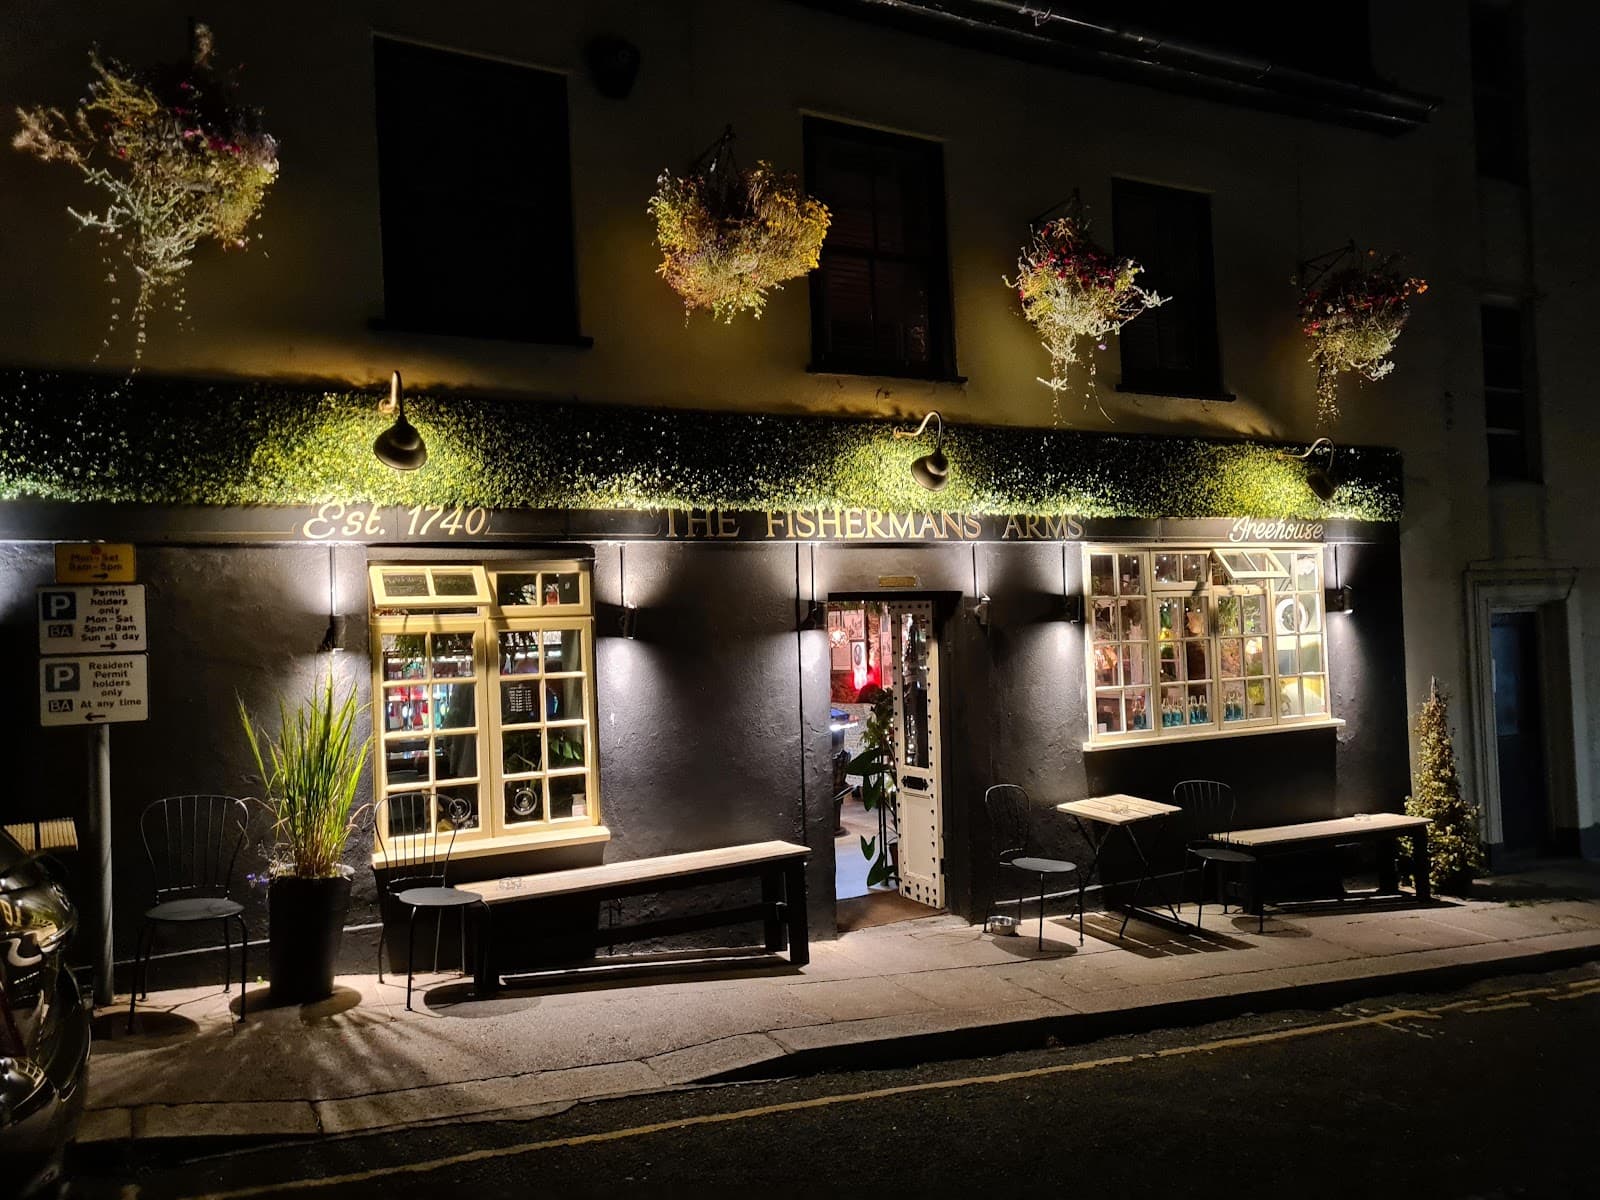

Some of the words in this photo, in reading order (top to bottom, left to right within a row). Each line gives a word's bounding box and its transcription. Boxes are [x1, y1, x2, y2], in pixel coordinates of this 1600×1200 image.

[302, 501, 386, 539] Est.
[407, 503, 486, 536] 1740
[666, 506, 741, 539] THE
[766, 506, 982, 540] FISHERMANS
[1002, 511, 1084, 540] ARMS
[93, 588, 125, 597] Permit
[51, 595, 70, 617] P
[90, 597, 128, 606] holders
[98, 606, 120, 615] only
[86, 615, 107, 623] Mon
[116, 614, 133, 623] Sat
[81, 633, 101, 642] Sun
[105, 633, 118, 641] all
[122, 632, 139, 641] day
[89, 660, 133, 670] Resident
[54, 667, 73, 689] P
[94, 669, 127, 678] Permit
[92, 679, 130, 688] holders
[101, 688, 122, 697] only
[50, 700, 72, 711] BA
[80, 699, 92, 708] At
[97, 701, 114, 709] any
[119, 697, 142, 706] time
